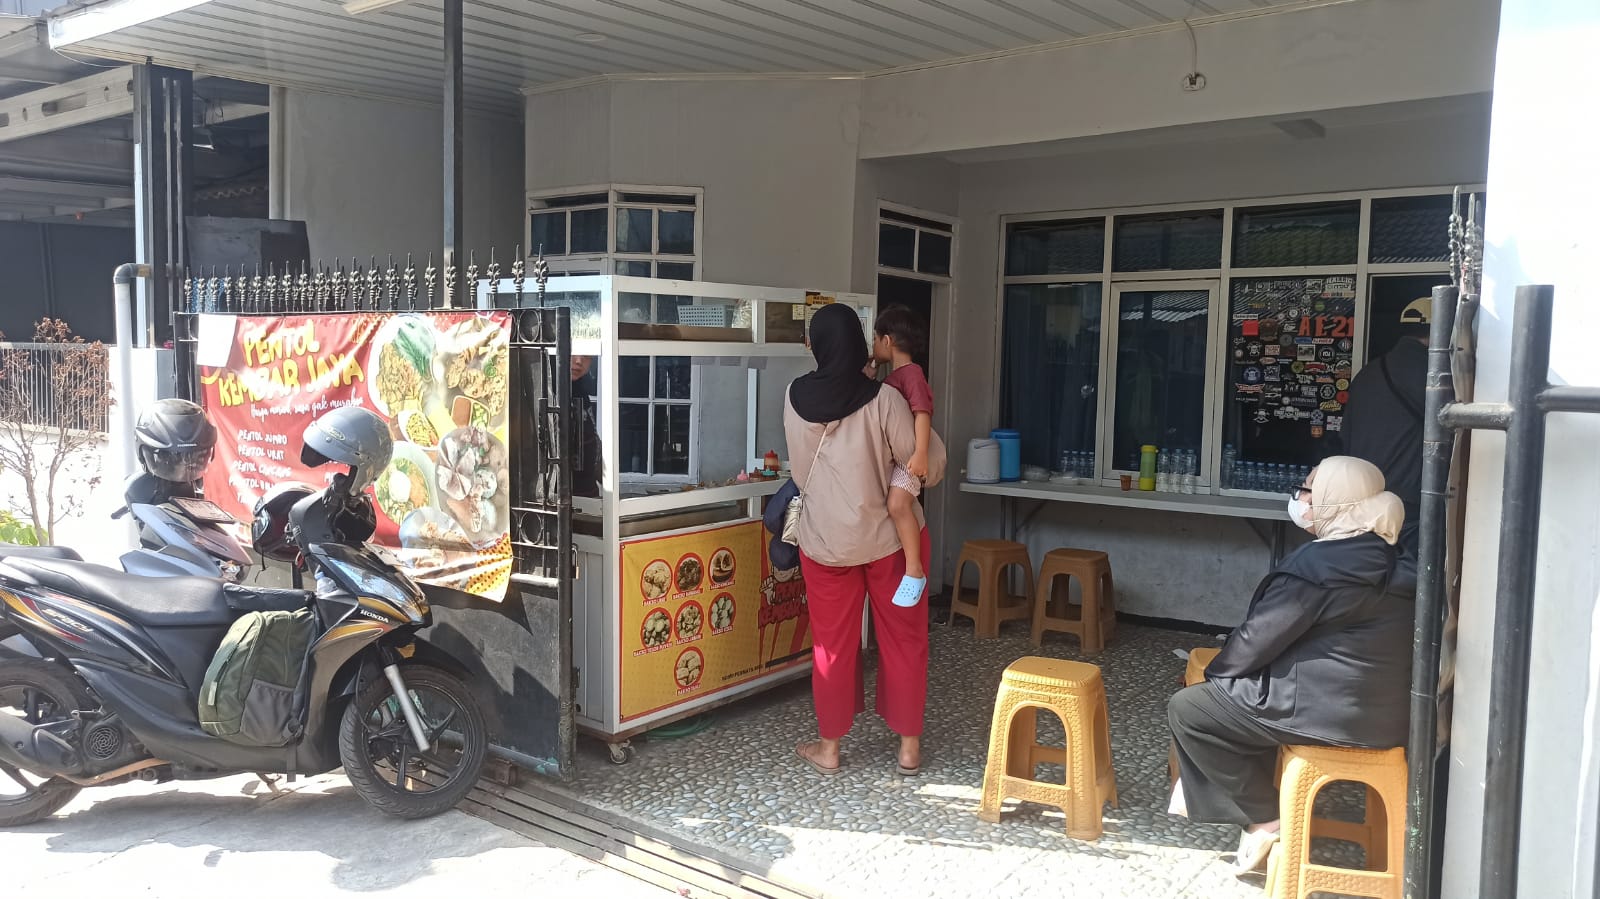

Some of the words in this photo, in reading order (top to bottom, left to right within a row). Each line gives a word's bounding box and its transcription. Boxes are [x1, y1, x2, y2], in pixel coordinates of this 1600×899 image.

[243, 319, 320, 367] PENTOL
[219, 358, 301, 406] KEMBAR
[306, 353, 365, 392] JAYA
[312, 394, 328, 418] gak
[238, 429, 263, 443] PENTOL
[238, 444, 265, 458] PENTOL
[232, 459, 257, 474] PENTOL
[360, 609, 389, 623] HONDA
